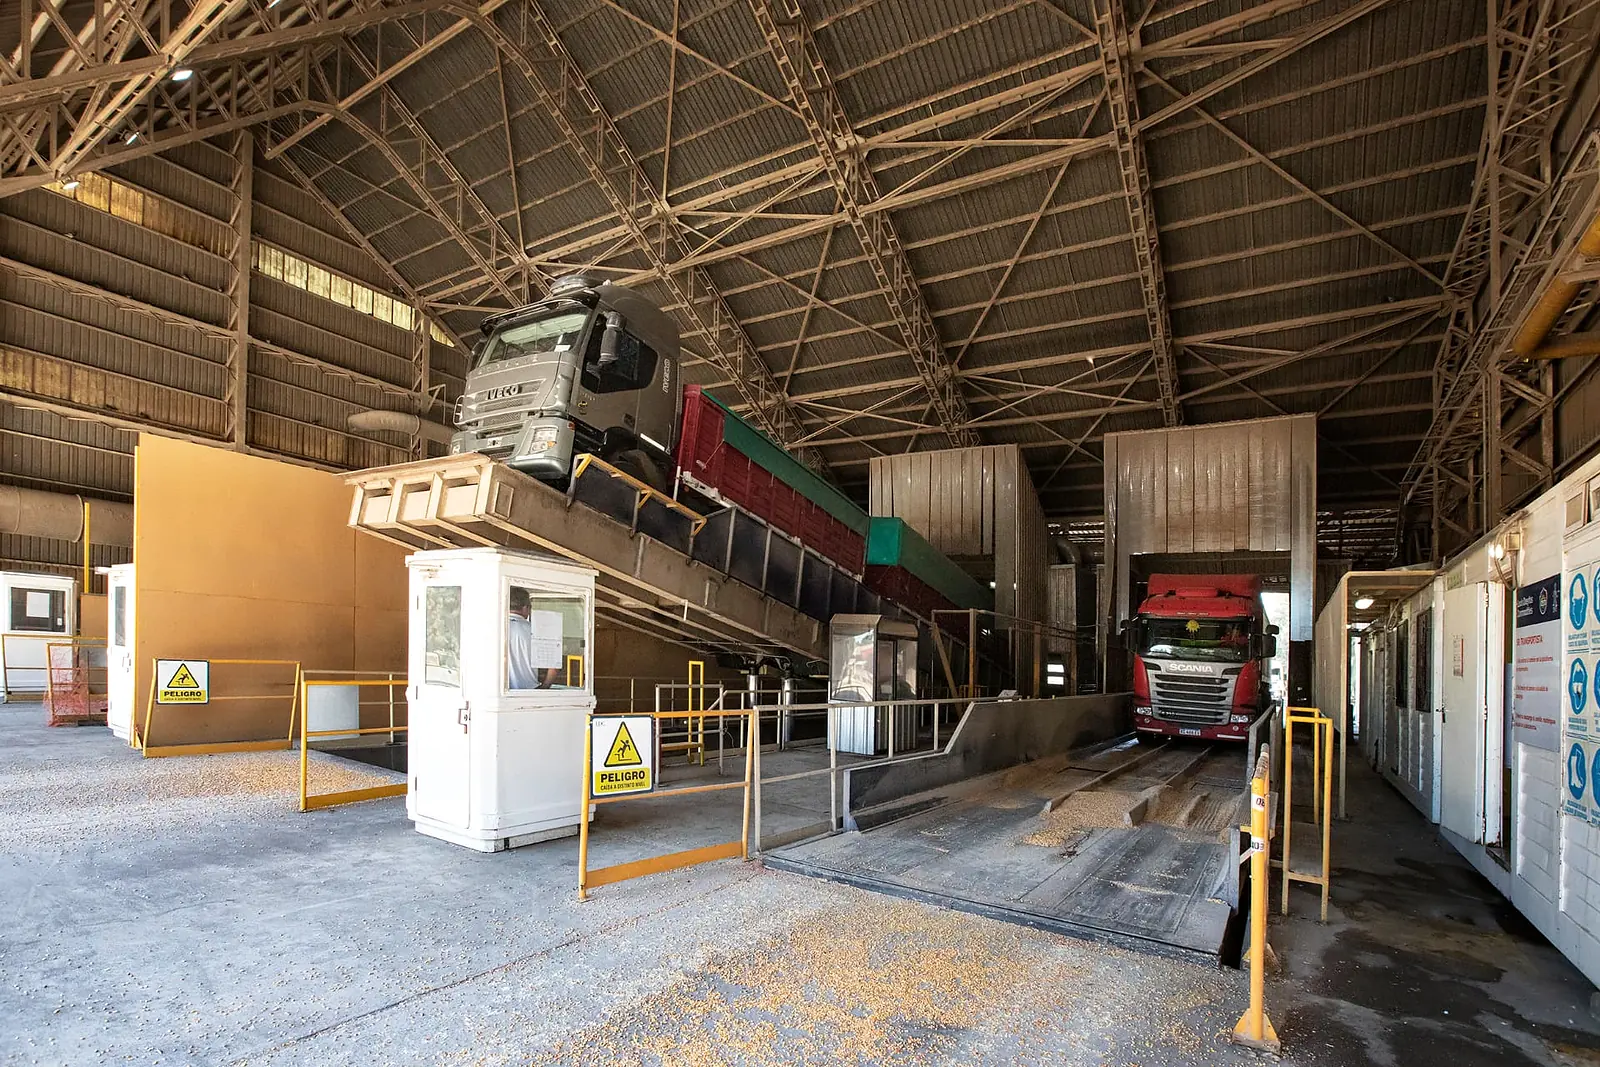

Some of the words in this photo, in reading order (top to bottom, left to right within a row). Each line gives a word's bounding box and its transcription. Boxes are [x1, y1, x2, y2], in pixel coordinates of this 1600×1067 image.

[487, 384, 520, 400] IVECO
[1168, 663, 1213, 673] SCANIA
[600, 770, 646, 783] PELIGRO
